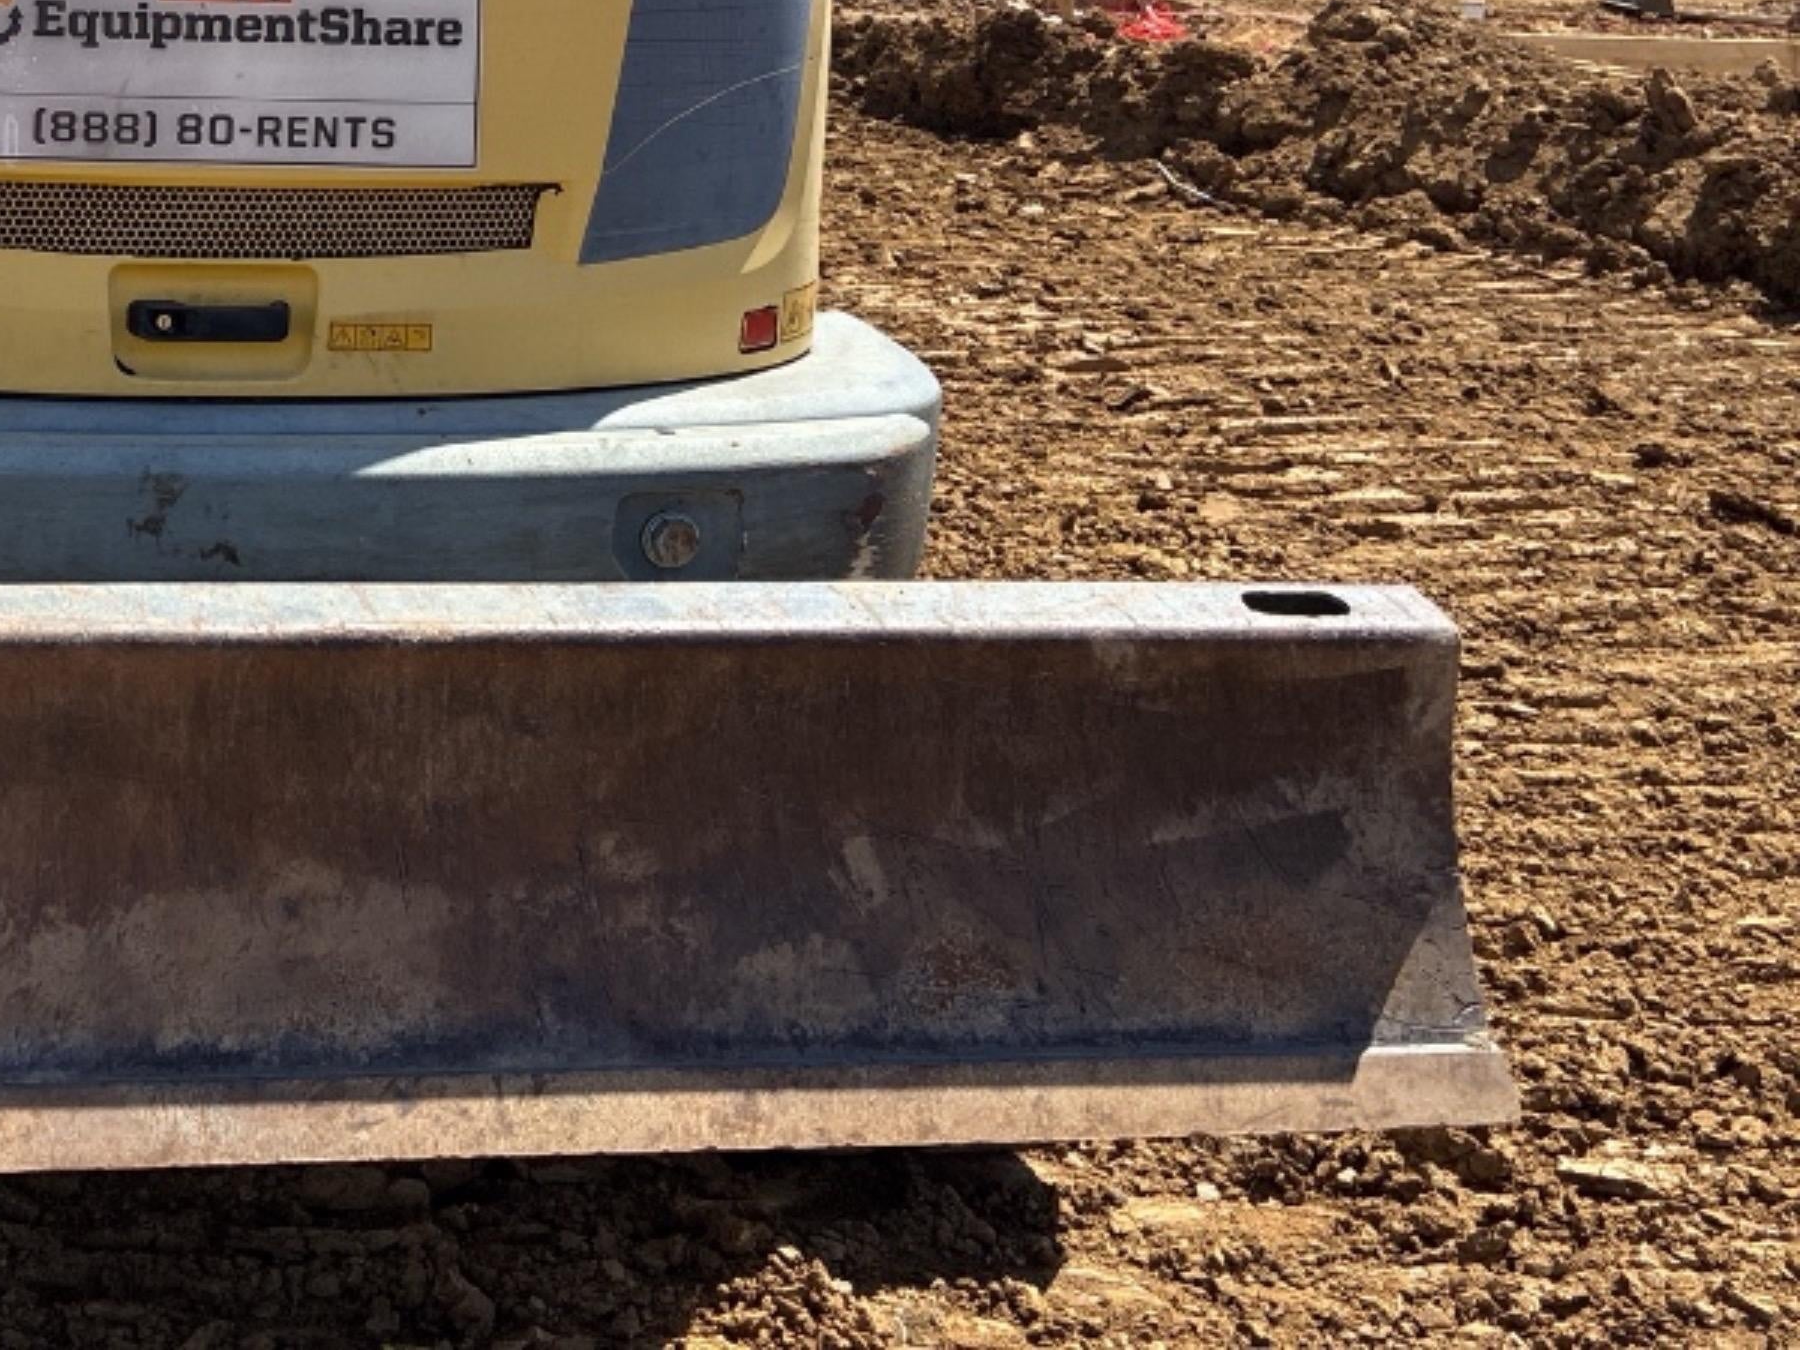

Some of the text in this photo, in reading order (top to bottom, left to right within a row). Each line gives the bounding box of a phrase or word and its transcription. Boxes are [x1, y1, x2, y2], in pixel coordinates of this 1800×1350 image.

[32, 0, 463, 49] EquipmentShare
[32, 107, 397, 149] (888) 80-RENTS
